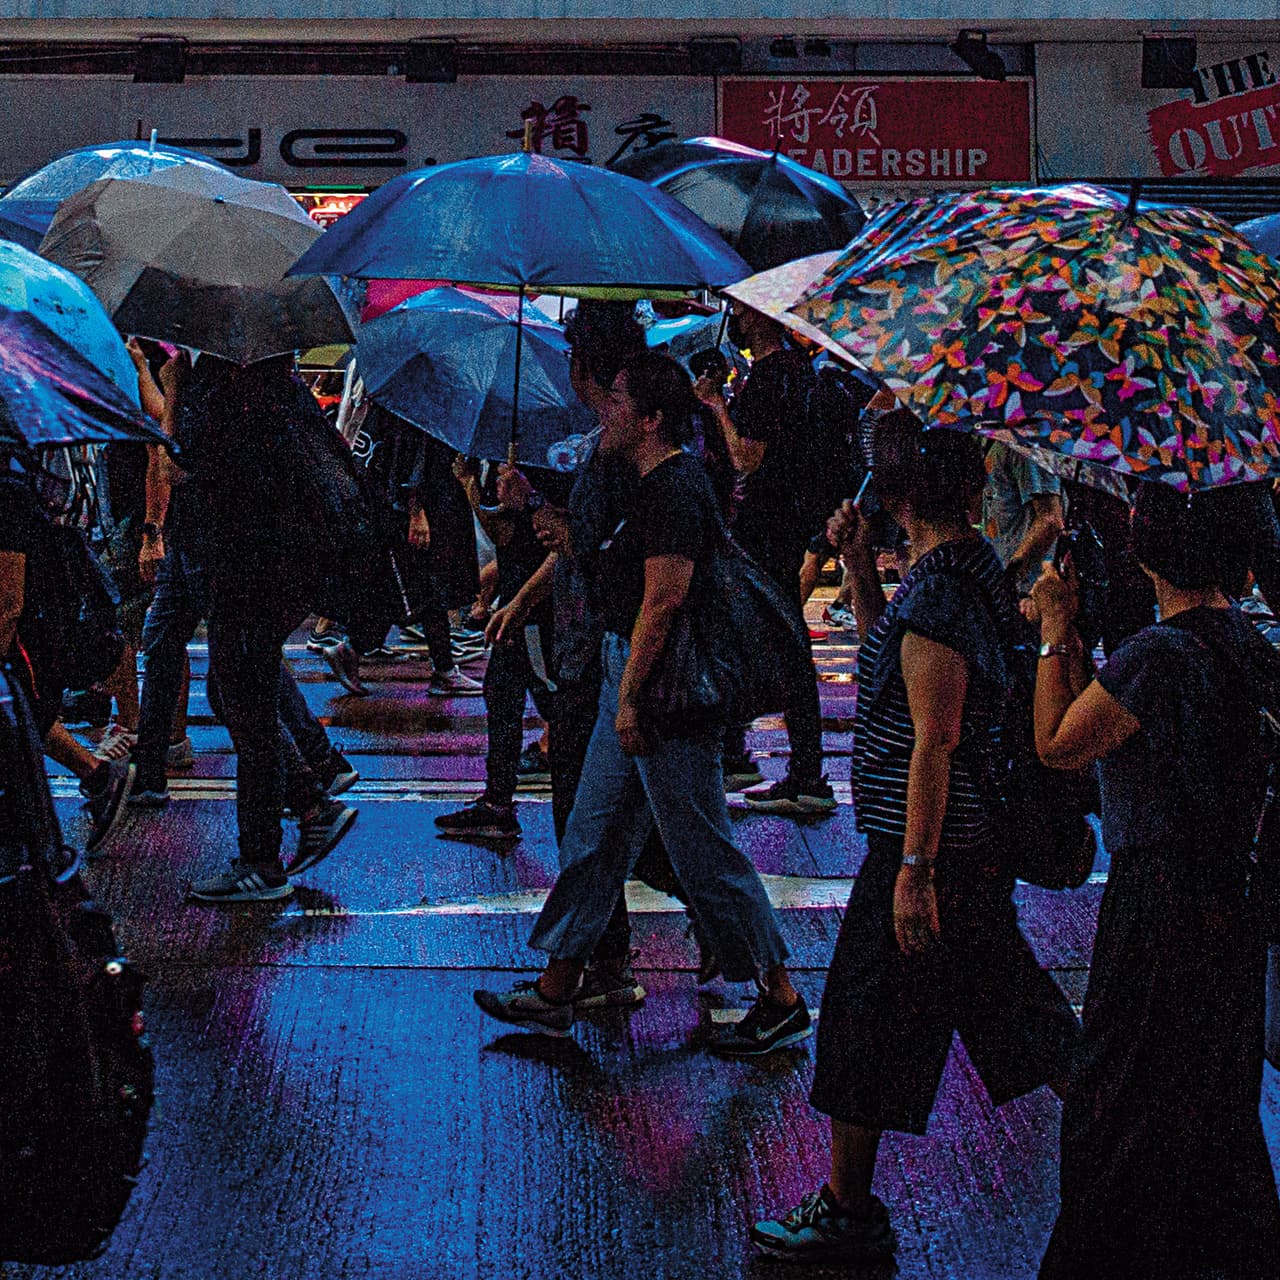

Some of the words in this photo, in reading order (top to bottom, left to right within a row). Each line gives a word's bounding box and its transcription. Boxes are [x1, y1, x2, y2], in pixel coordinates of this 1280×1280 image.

[1192, 51, 1277, 104] THE
[761, 83, 882, 146] 將領
[786, 148, 989, 176] EADERSHIP
